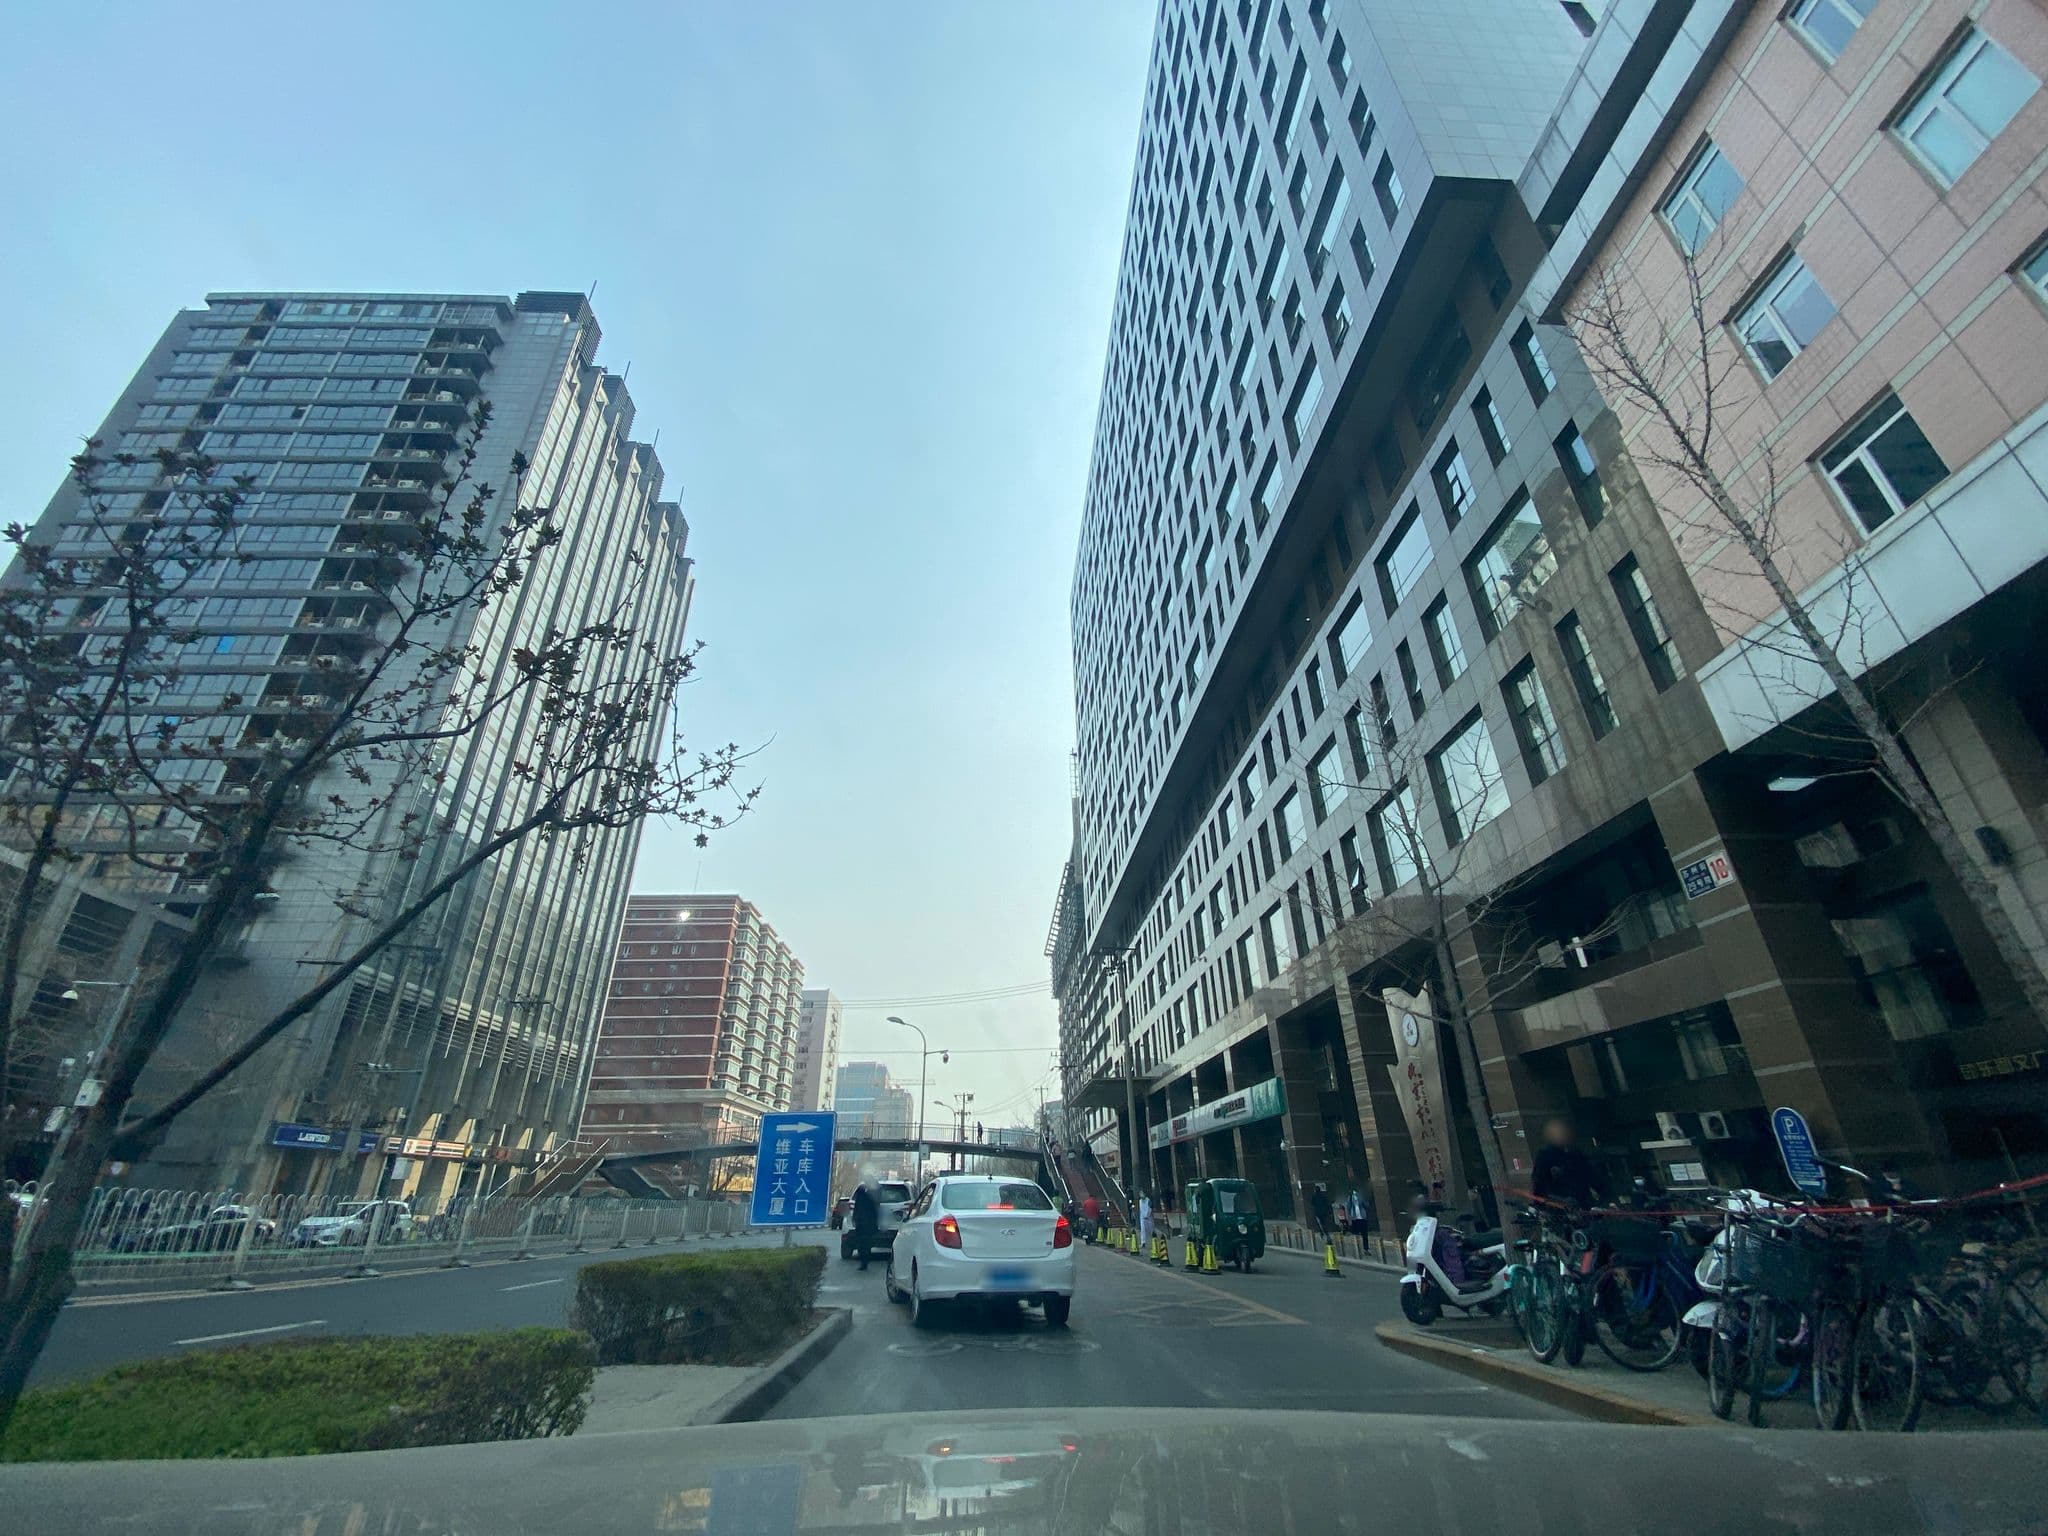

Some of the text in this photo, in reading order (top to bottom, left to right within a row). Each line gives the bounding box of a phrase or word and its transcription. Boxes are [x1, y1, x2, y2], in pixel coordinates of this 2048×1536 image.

[297, 1132, 331, 1143] LAWSON
[1784, 1118, 1794, 1133] P
[768, 1138, 792, 1216] 维亚大厦
[794, 1138, 815, 1214] 车库入口
